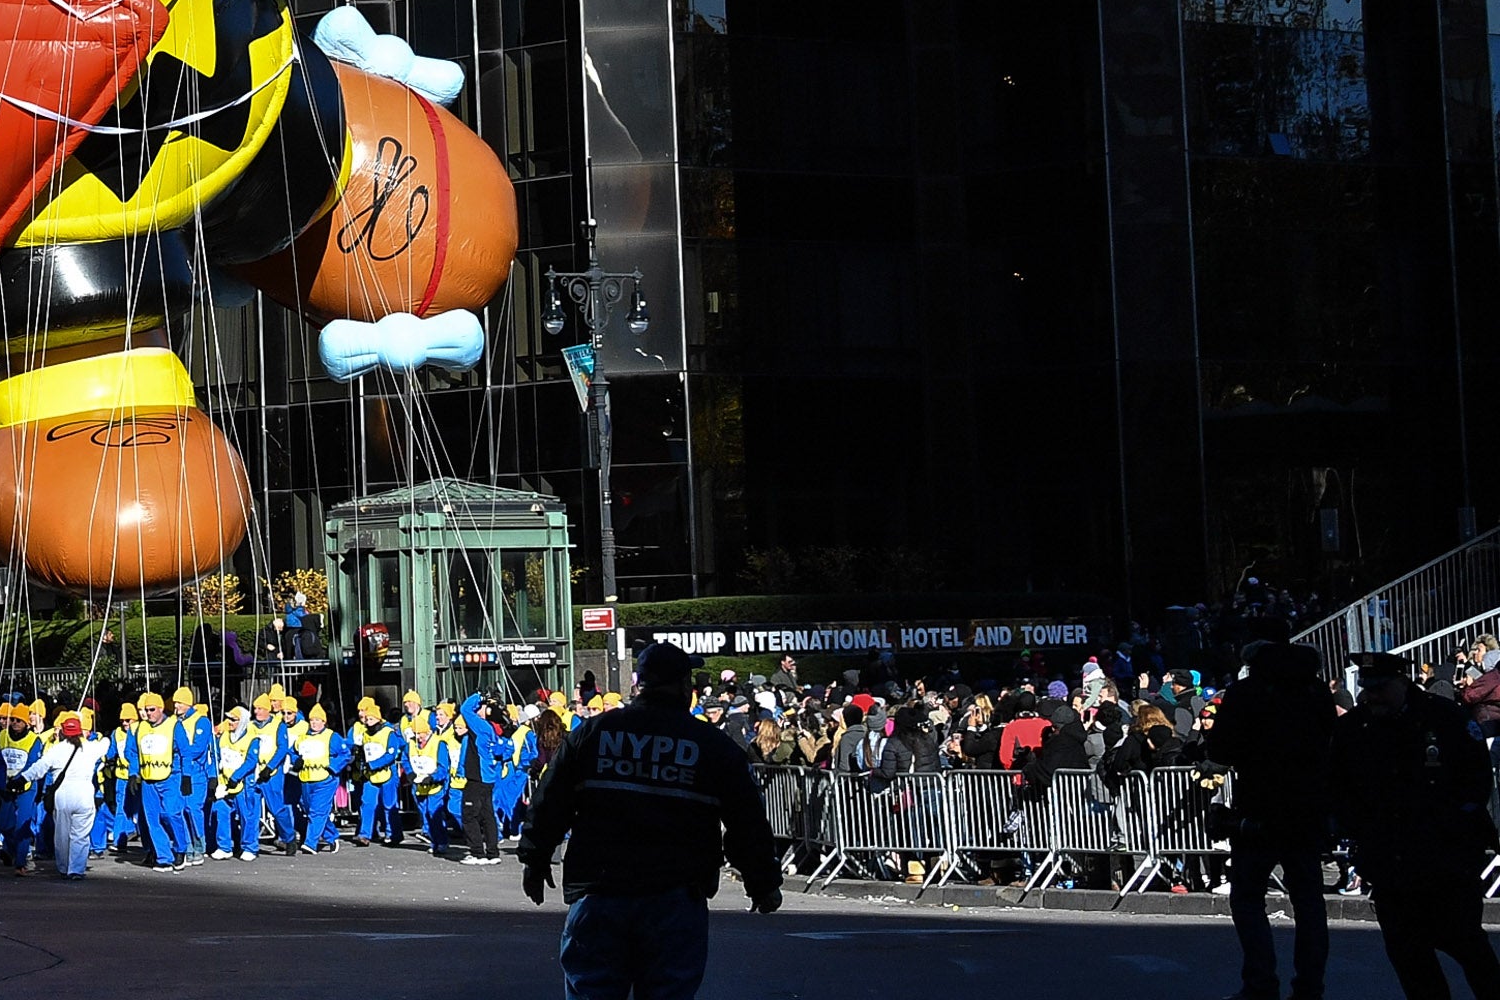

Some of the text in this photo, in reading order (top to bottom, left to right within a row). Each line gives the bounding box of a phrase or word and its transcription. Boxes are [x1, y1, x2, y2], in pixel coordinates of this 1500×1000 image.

[468, 644, 497, 652] Columbus
[514, 643, 536, 651] Station
[653, 624, 1088, 654] TRUMP INTERNATIONAL HOTEL AND TOWER
[598, 730, 700, 767] NYPD
[596, 757, 697, 785] POLICE
